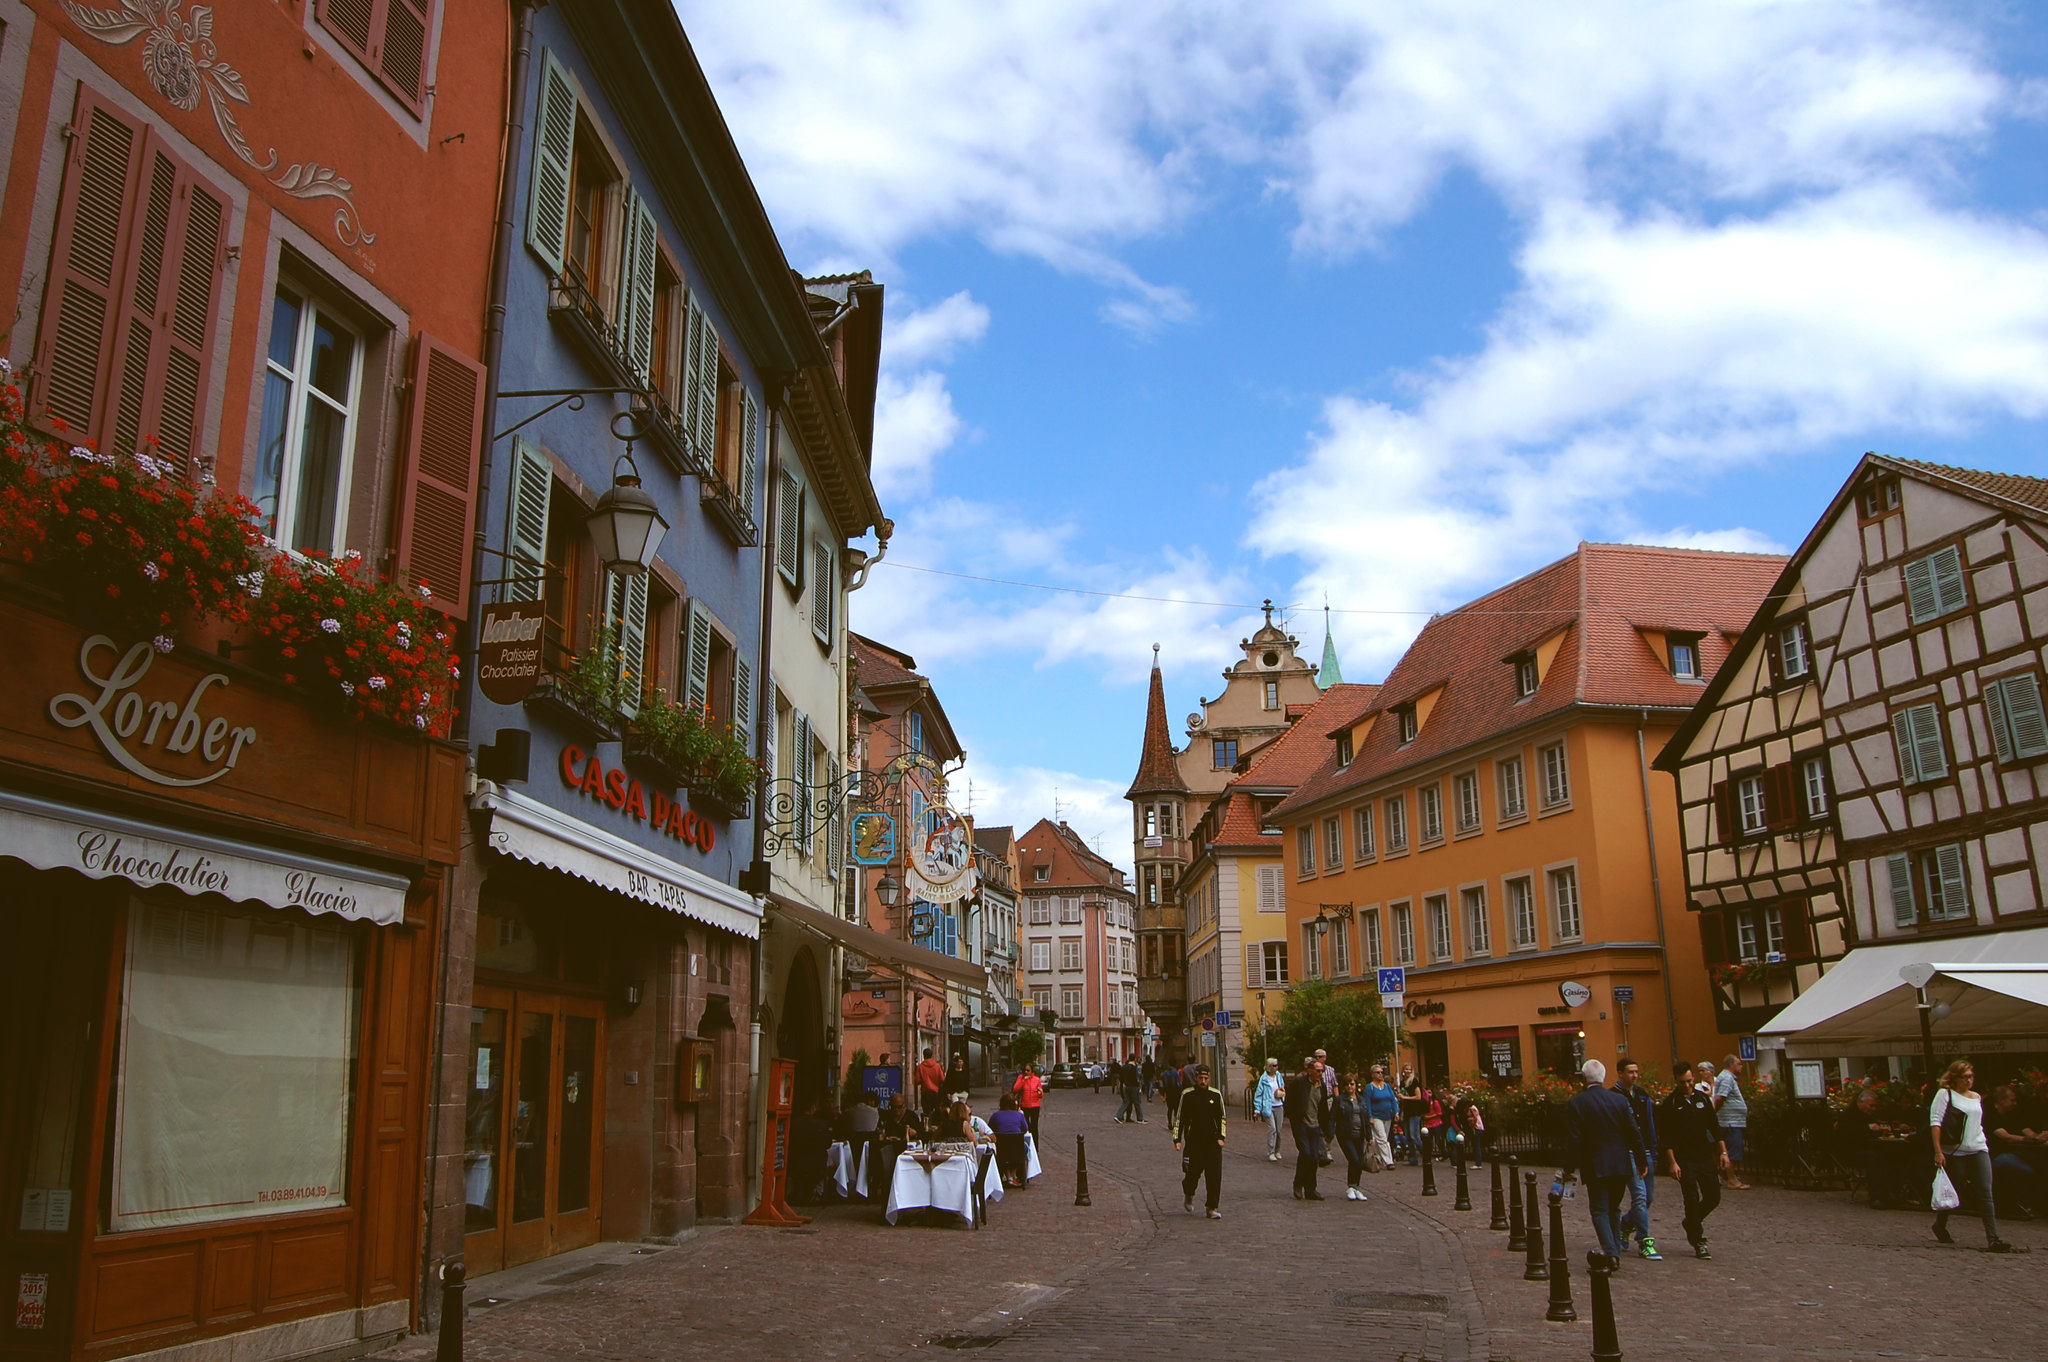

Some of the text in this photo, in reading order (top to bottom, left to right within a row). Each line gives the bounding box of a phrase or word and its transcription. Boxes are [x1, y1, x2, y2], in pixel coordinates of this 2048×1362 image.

[482, 611, 542, 644] Lorber
[480, 663, 538, 679] Chocolatier
[50, 634, 256, 787] Lorber
[561, 744, 715, 852] CASA PACO
[77, 830, 358, 914] Chocolatier Glacier
[628, 871, 650, 896] BAR
[659, 882, 686, 909] TAPAS
[1564, 988, 1588, 997] Casino
[1406, 999, 1445, 1020] Casino
[23, 1283, 43, 1295] 2015
